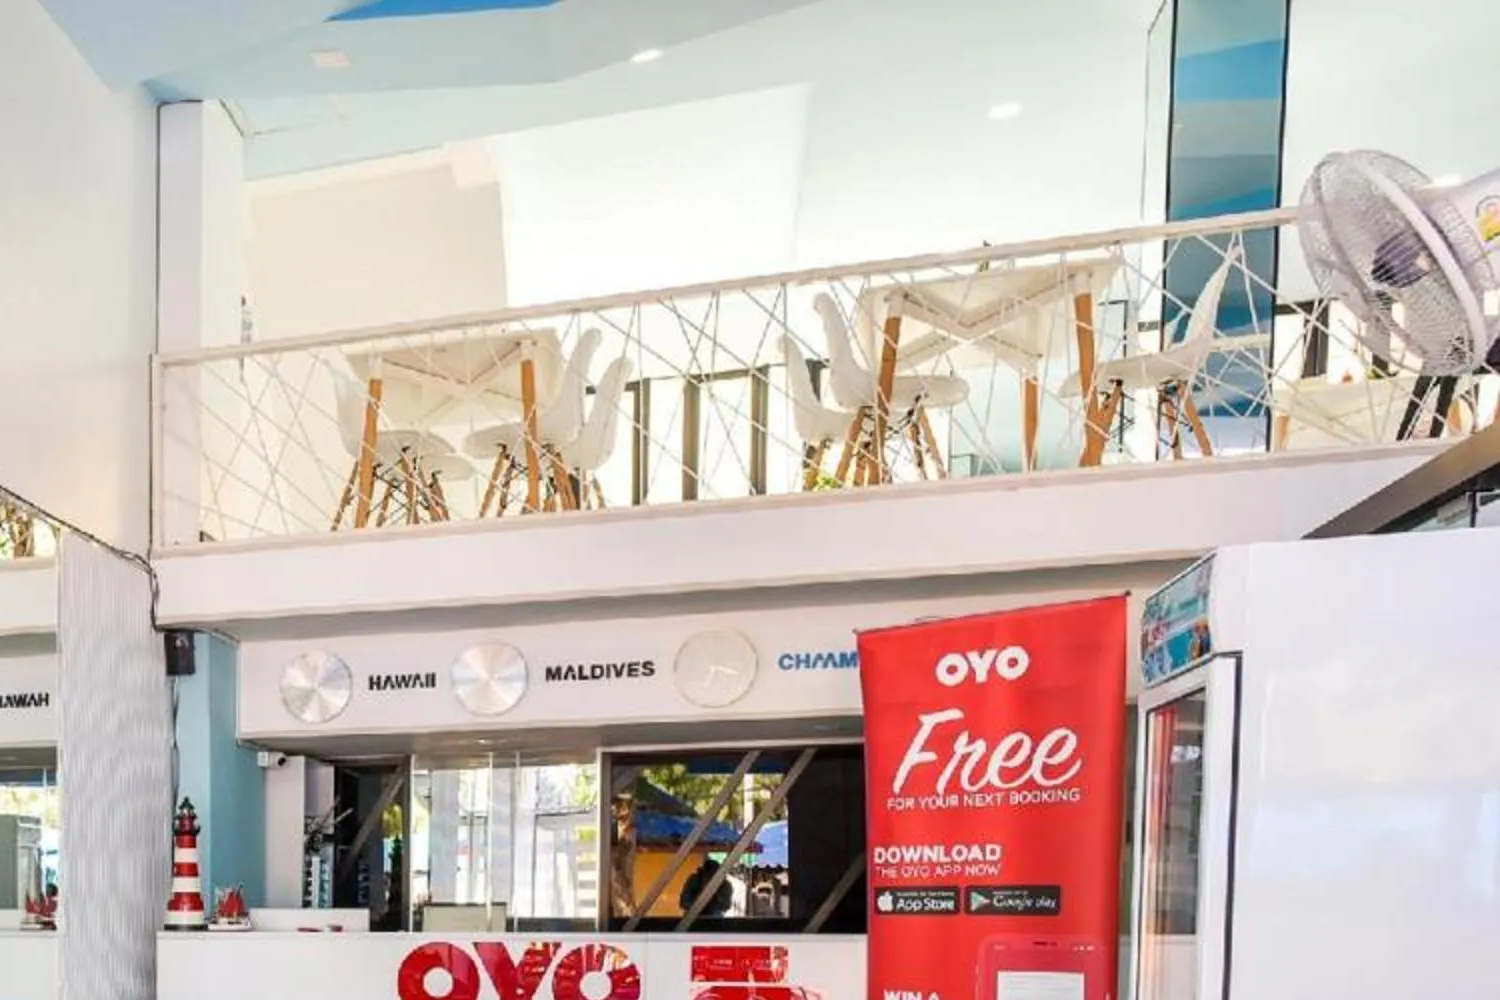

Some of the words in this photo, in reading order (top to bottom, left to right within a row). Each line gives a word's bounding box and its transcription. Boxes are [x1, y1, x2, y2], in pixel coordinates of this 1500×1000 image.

[544, 660, 657, 683] MALDIVES
[935, 645, 1030, 687] OYO
[368, 671, 437, 692] HAWAII
[892, 707, 1083, 796] Free
[887, 797, 915, 812] FOR
[918, 794, 959, 810] YOUR
[963, 792, 1003, 808] NEXT
[1009, 788, 1081, 806] BOOKING
[873, 843, 1002, 864] DOWNLOAD
[901, 865, 930, 878] OYO
[934, 864, 962, 877] APP
[965, 863, 1001, 876] NOW
[896, 898, 923, 912] App
[924, 897, 956, 911] Store
[992, 895, 1033, 911] Google
